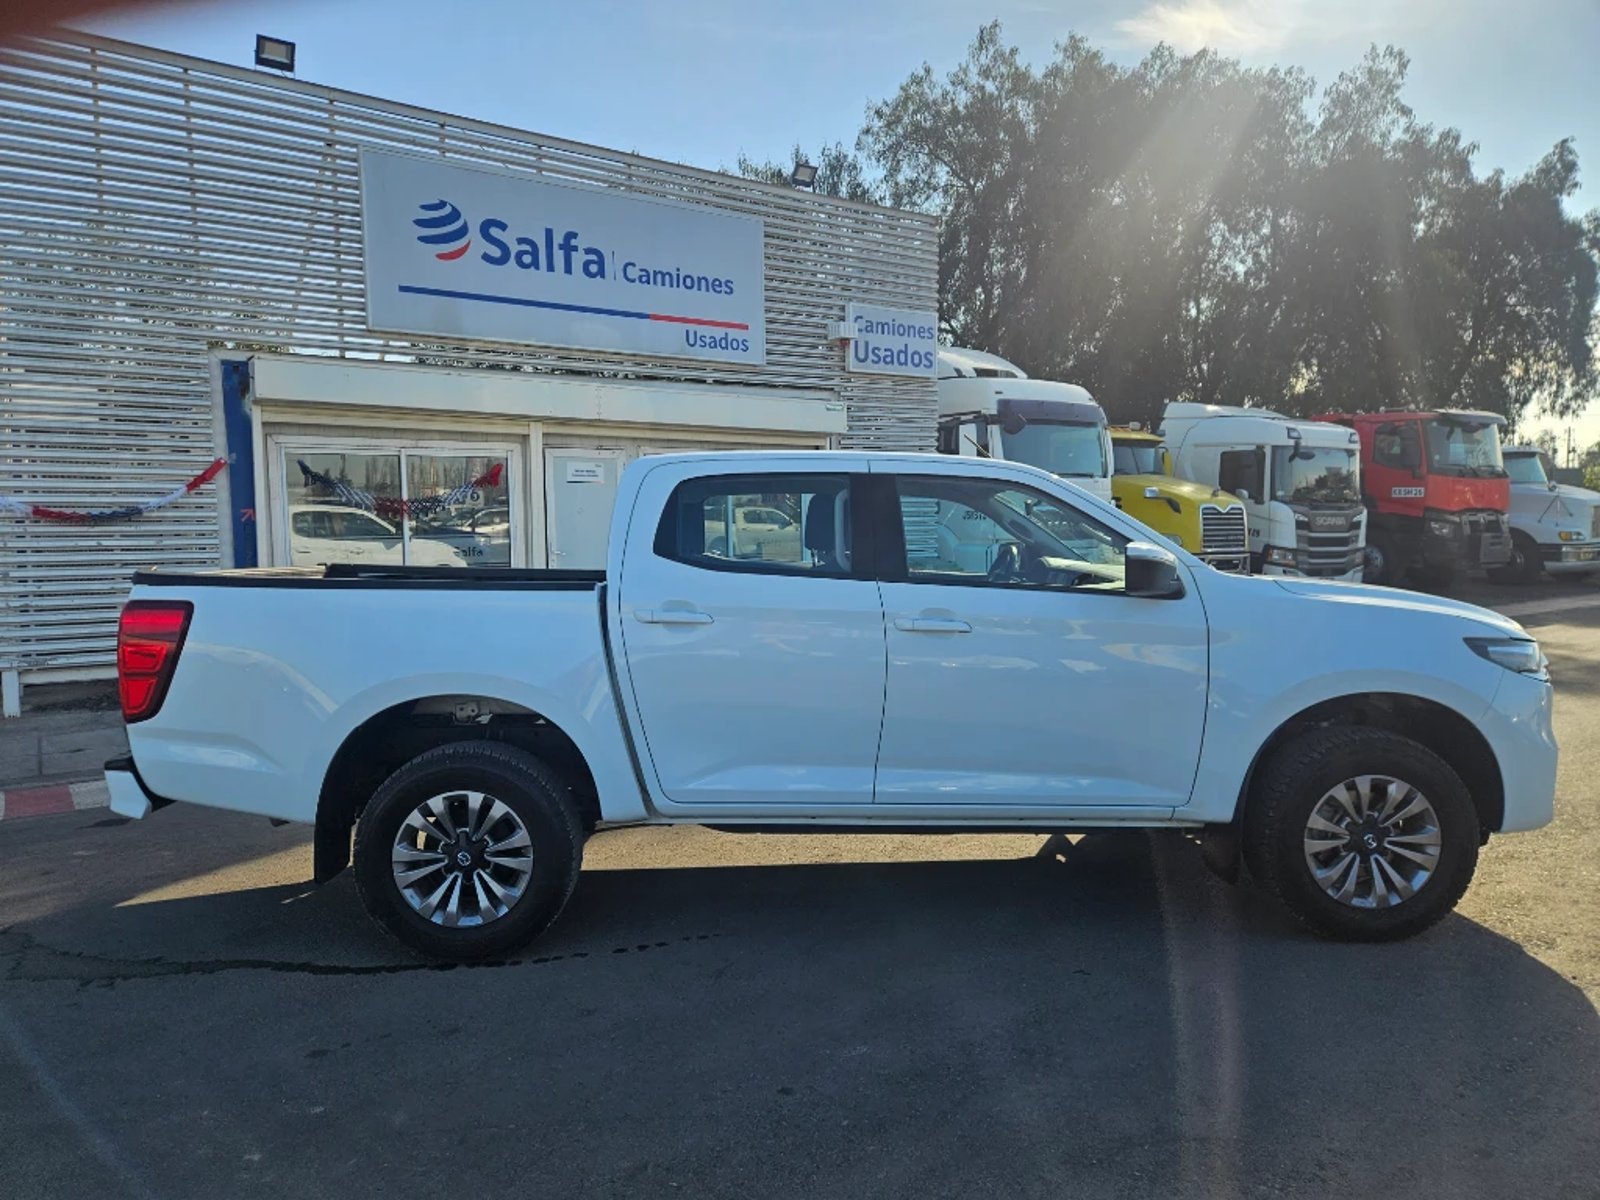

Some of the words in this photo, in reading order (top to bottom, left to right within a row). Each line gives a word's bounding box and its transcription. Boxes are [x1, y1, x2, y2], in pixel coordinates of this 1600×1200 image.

[479, 218, 606, 280] Salfa
[622, 261, 734, 295] Camiones
[685, 329, 749, 352] Usados
[854, 340, 934, 369] Usados
[1314, 516, 1347, 526] SCANIA
